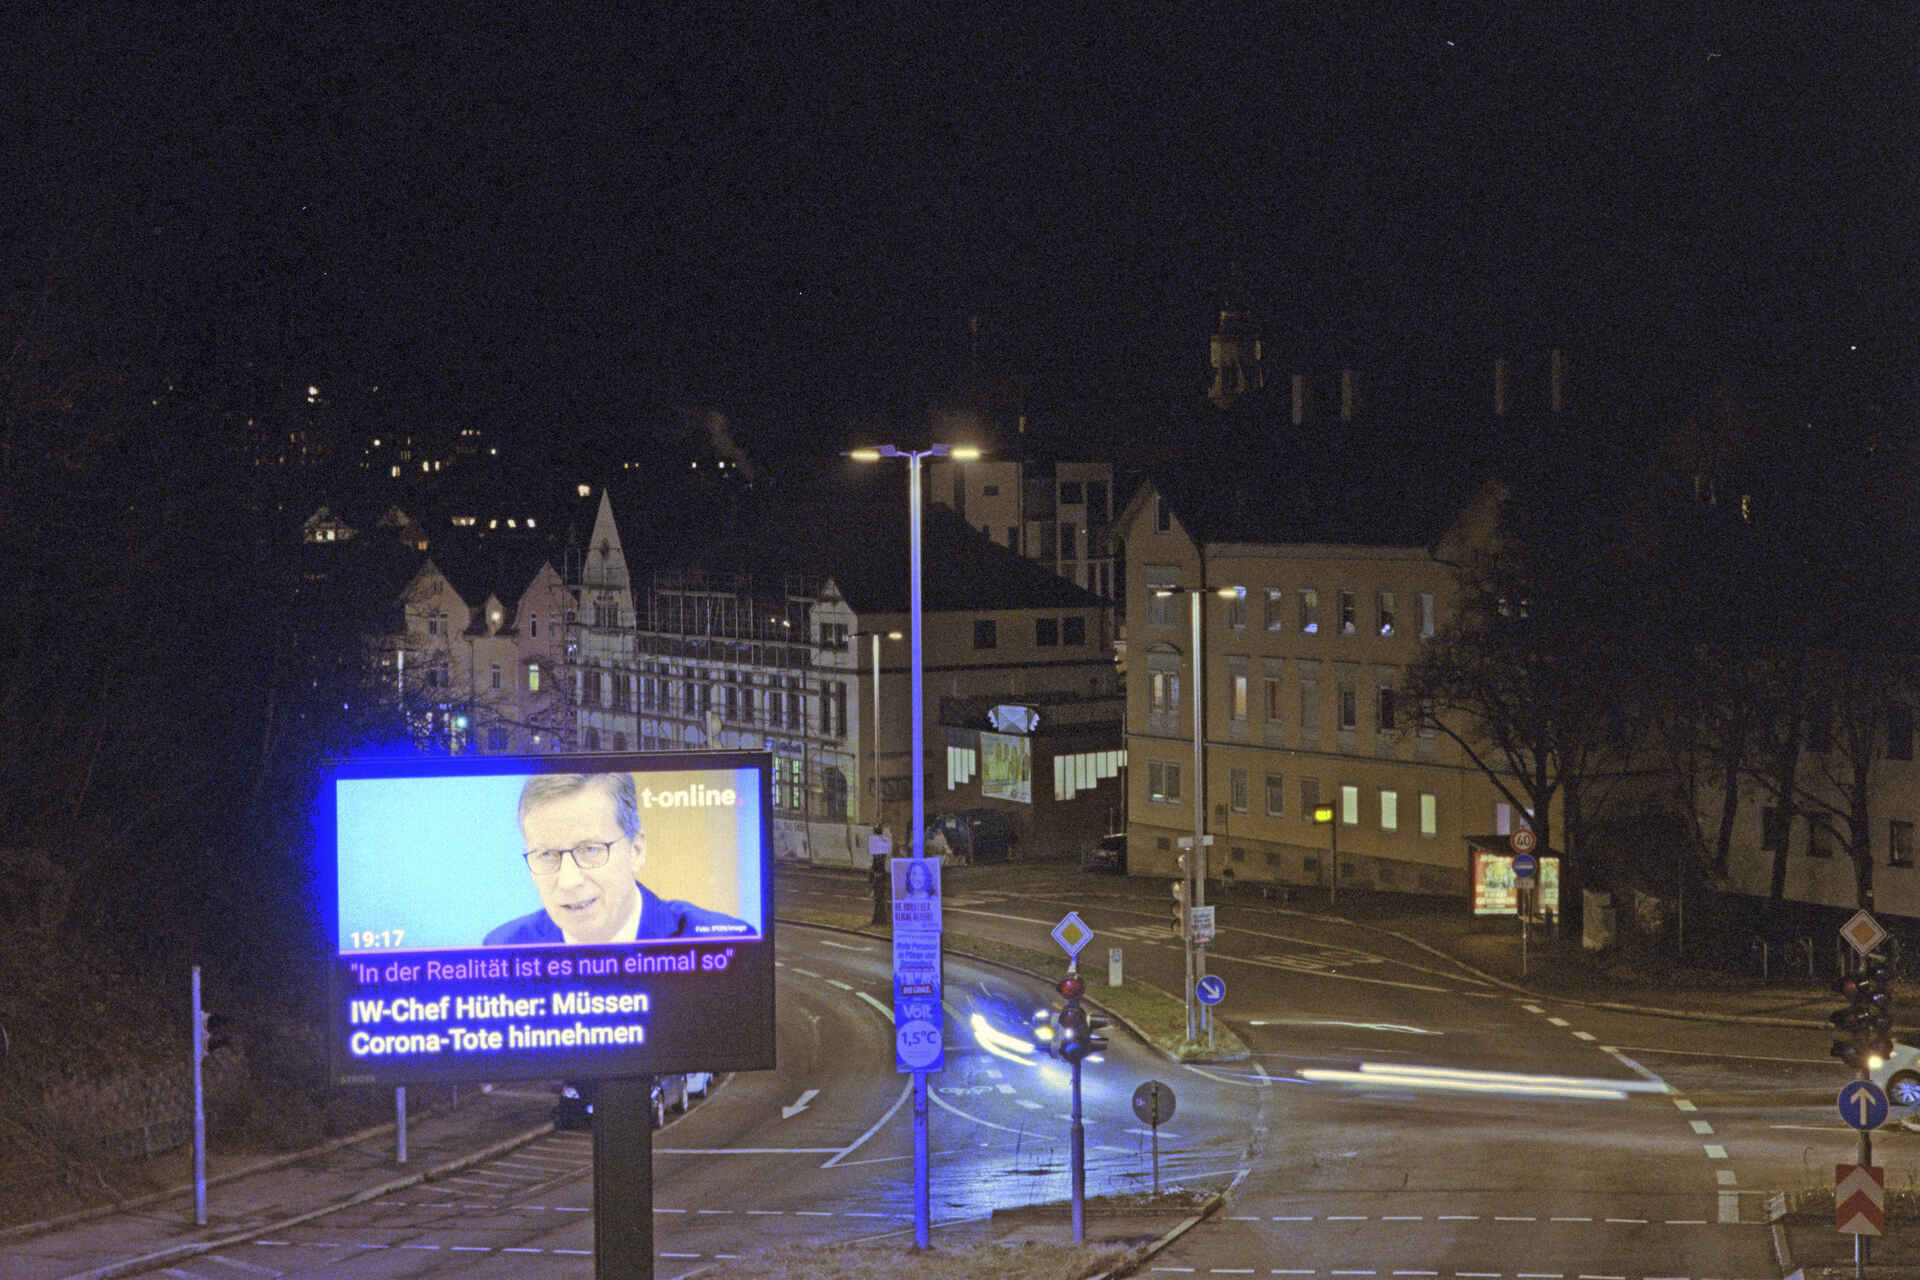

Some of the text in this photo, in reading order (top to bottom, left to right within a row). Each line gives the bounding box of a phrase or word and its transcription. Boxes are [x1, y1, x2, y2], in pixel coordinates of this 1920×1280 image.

[351, 930, 405, 948] 19:17
[351, 948, 734, 983] "In der Realität ist es nun einmal so"
[351, 991, 649, 1024] IW-Chef Hüther: Müssen
[902, 1003, 933, 1020] Volt
[351, 1022, 644, 1055] Corona-Tote hinnehmen
[901, 1030, 937, 1047] 1,5°C
